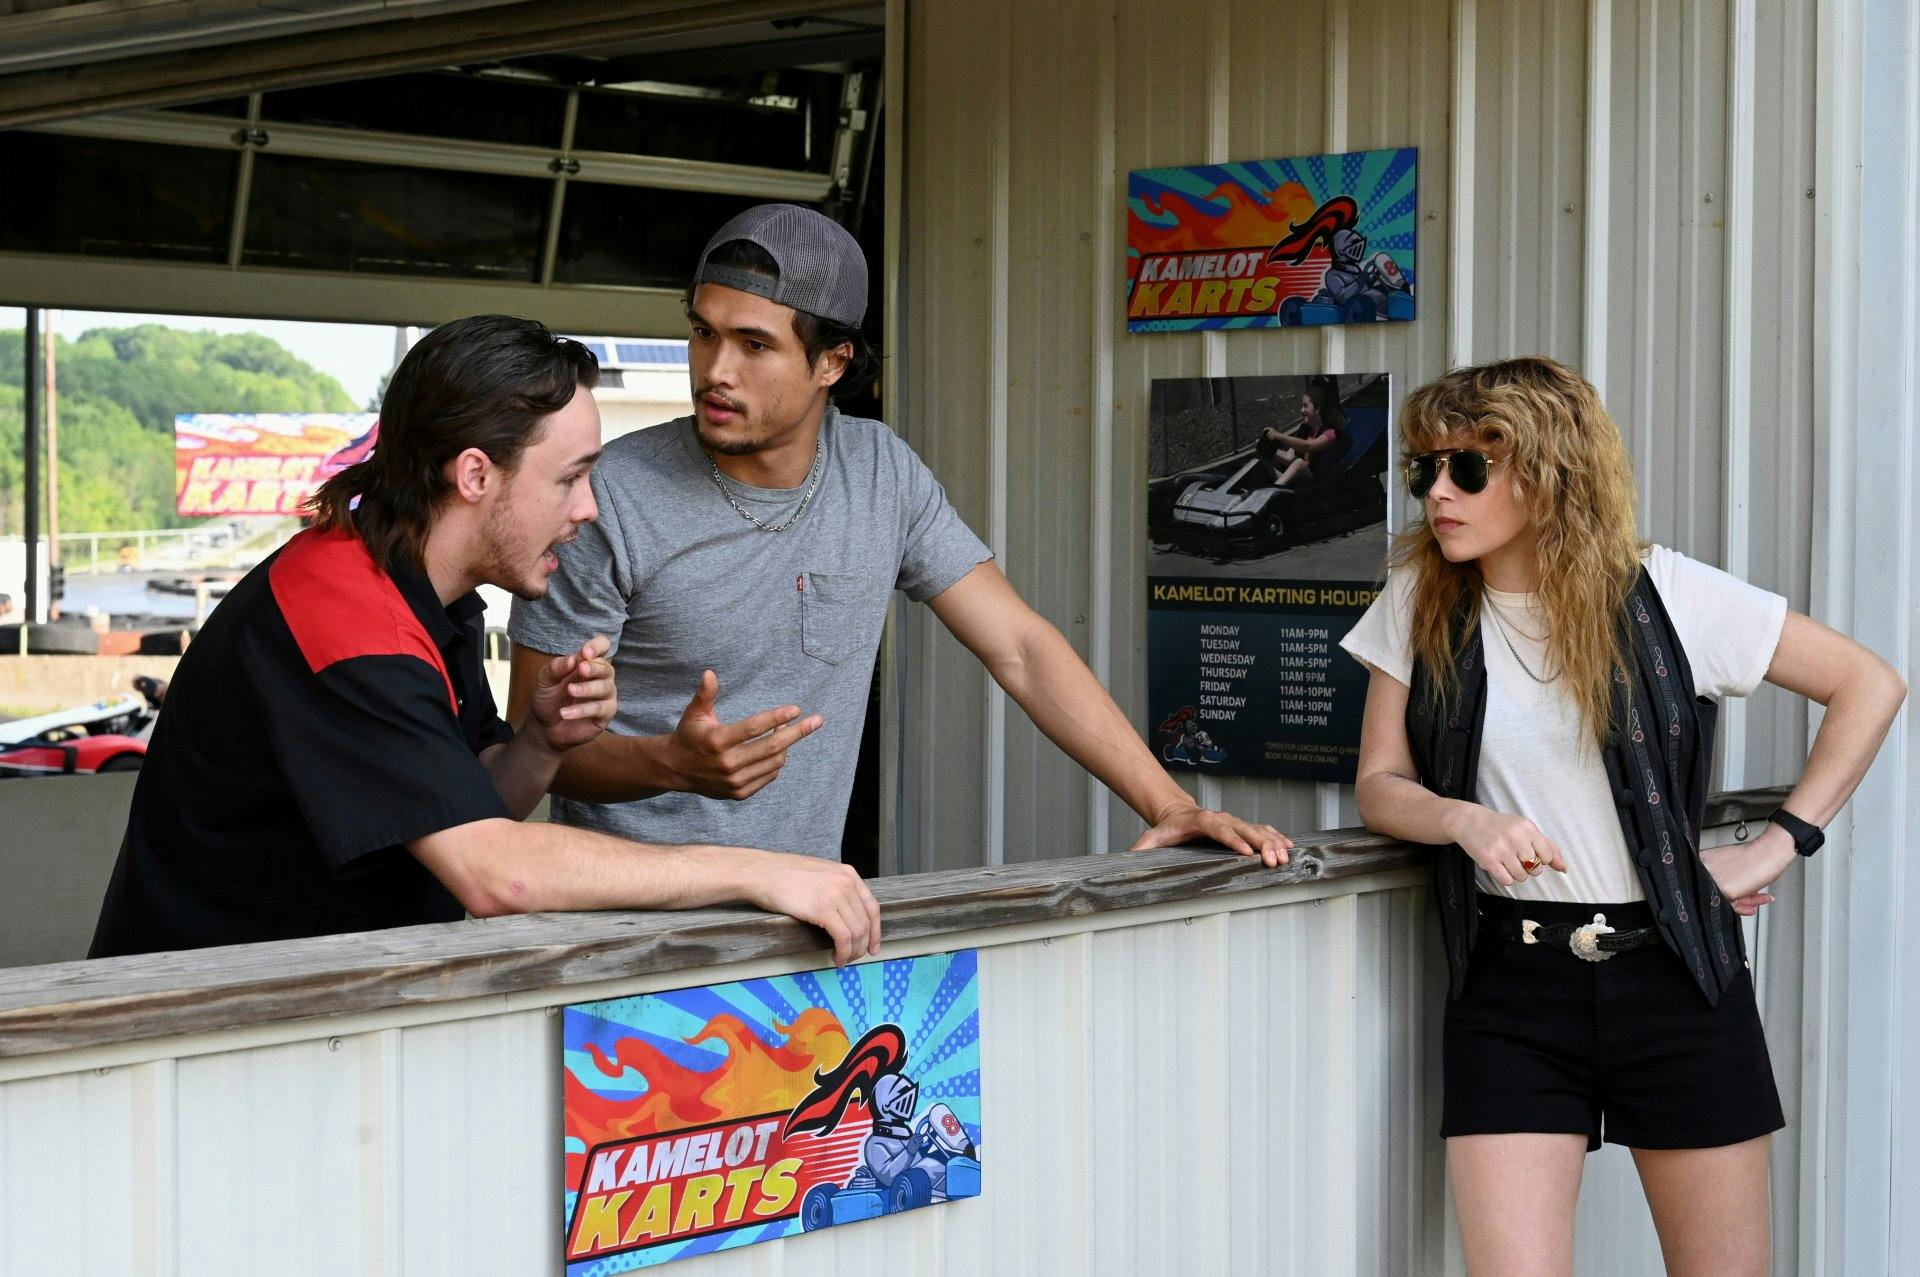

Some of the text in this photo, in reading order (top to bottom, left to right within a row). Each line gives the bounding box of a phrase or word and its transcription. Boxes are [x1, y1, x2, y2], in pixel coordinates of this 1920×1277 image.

[1139, 252, 1264, 282] KAMELOT
[1129, 276, 1281, 317] KARTS
[180, 480, 326, 513] KART
[1154, 585, 1236, 602] KAMELOT
[1239, 587, 1316, 605] KARTING
[1200, 625, 1328, 639] MONDAY 11AM-9PM
[1200, 639, 1328, 654] TUESDAY 11AM-5PM
[1200, 653, 1256, 665] WEDNESDAY
[1200, 667, 1247, 679] THURSDAY
[1200, 681, 1231, 692] FRIDAY
[1200, 695, 1332, 712] SATURDAY 11AM-10PM
[1200, 709, 1328, 726] SUNDAY 11AM-9PM
[941, 1113, 960, 1136] 8
[587, 1120, 779, 1193] KAMELOT
[571, 1157, 804, 1255] KARTS
